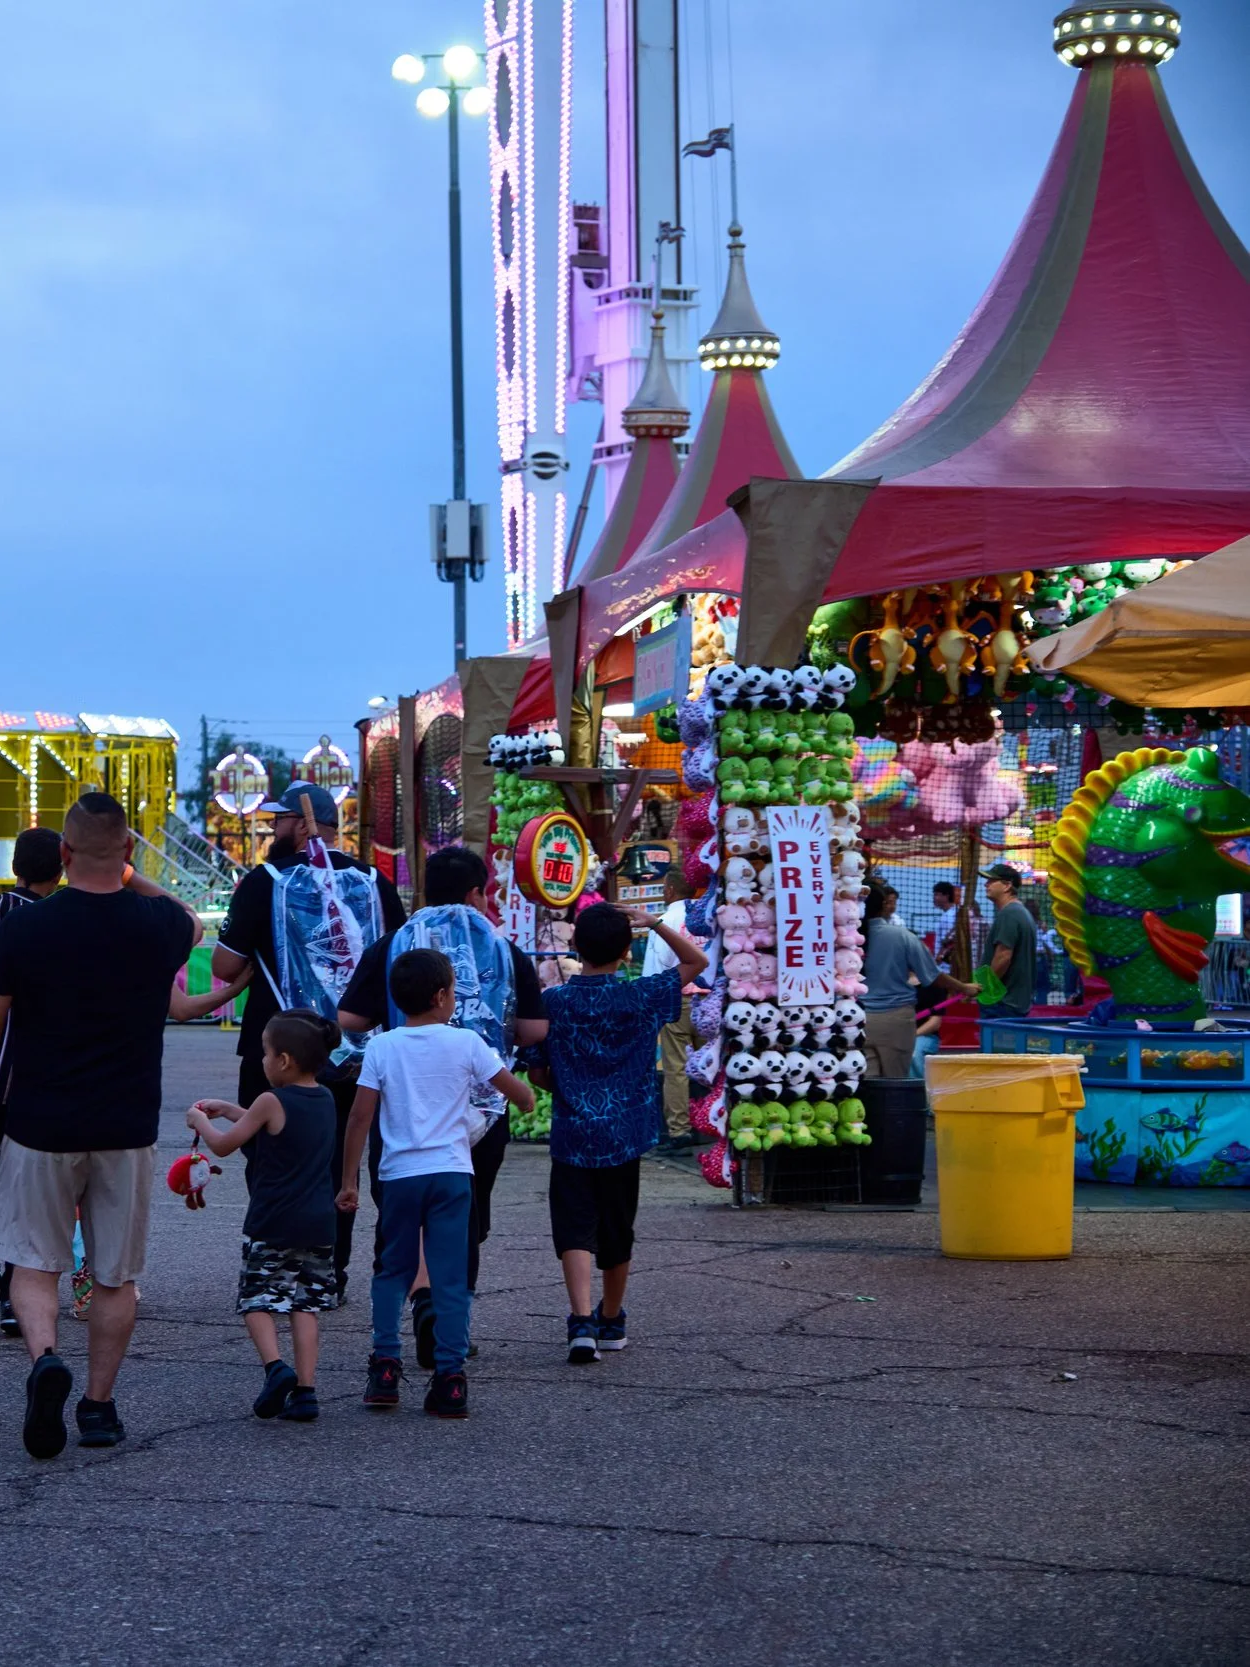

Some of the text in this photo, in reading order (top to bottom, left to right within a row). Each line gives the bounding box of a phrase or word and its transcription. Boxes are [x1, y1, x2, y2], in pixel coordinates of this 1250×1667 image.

[209, 761, 269, 796] Titan
[778, 841, 804, 968] PRIZE
[809, 841, 828, 966] EVERY TIME
